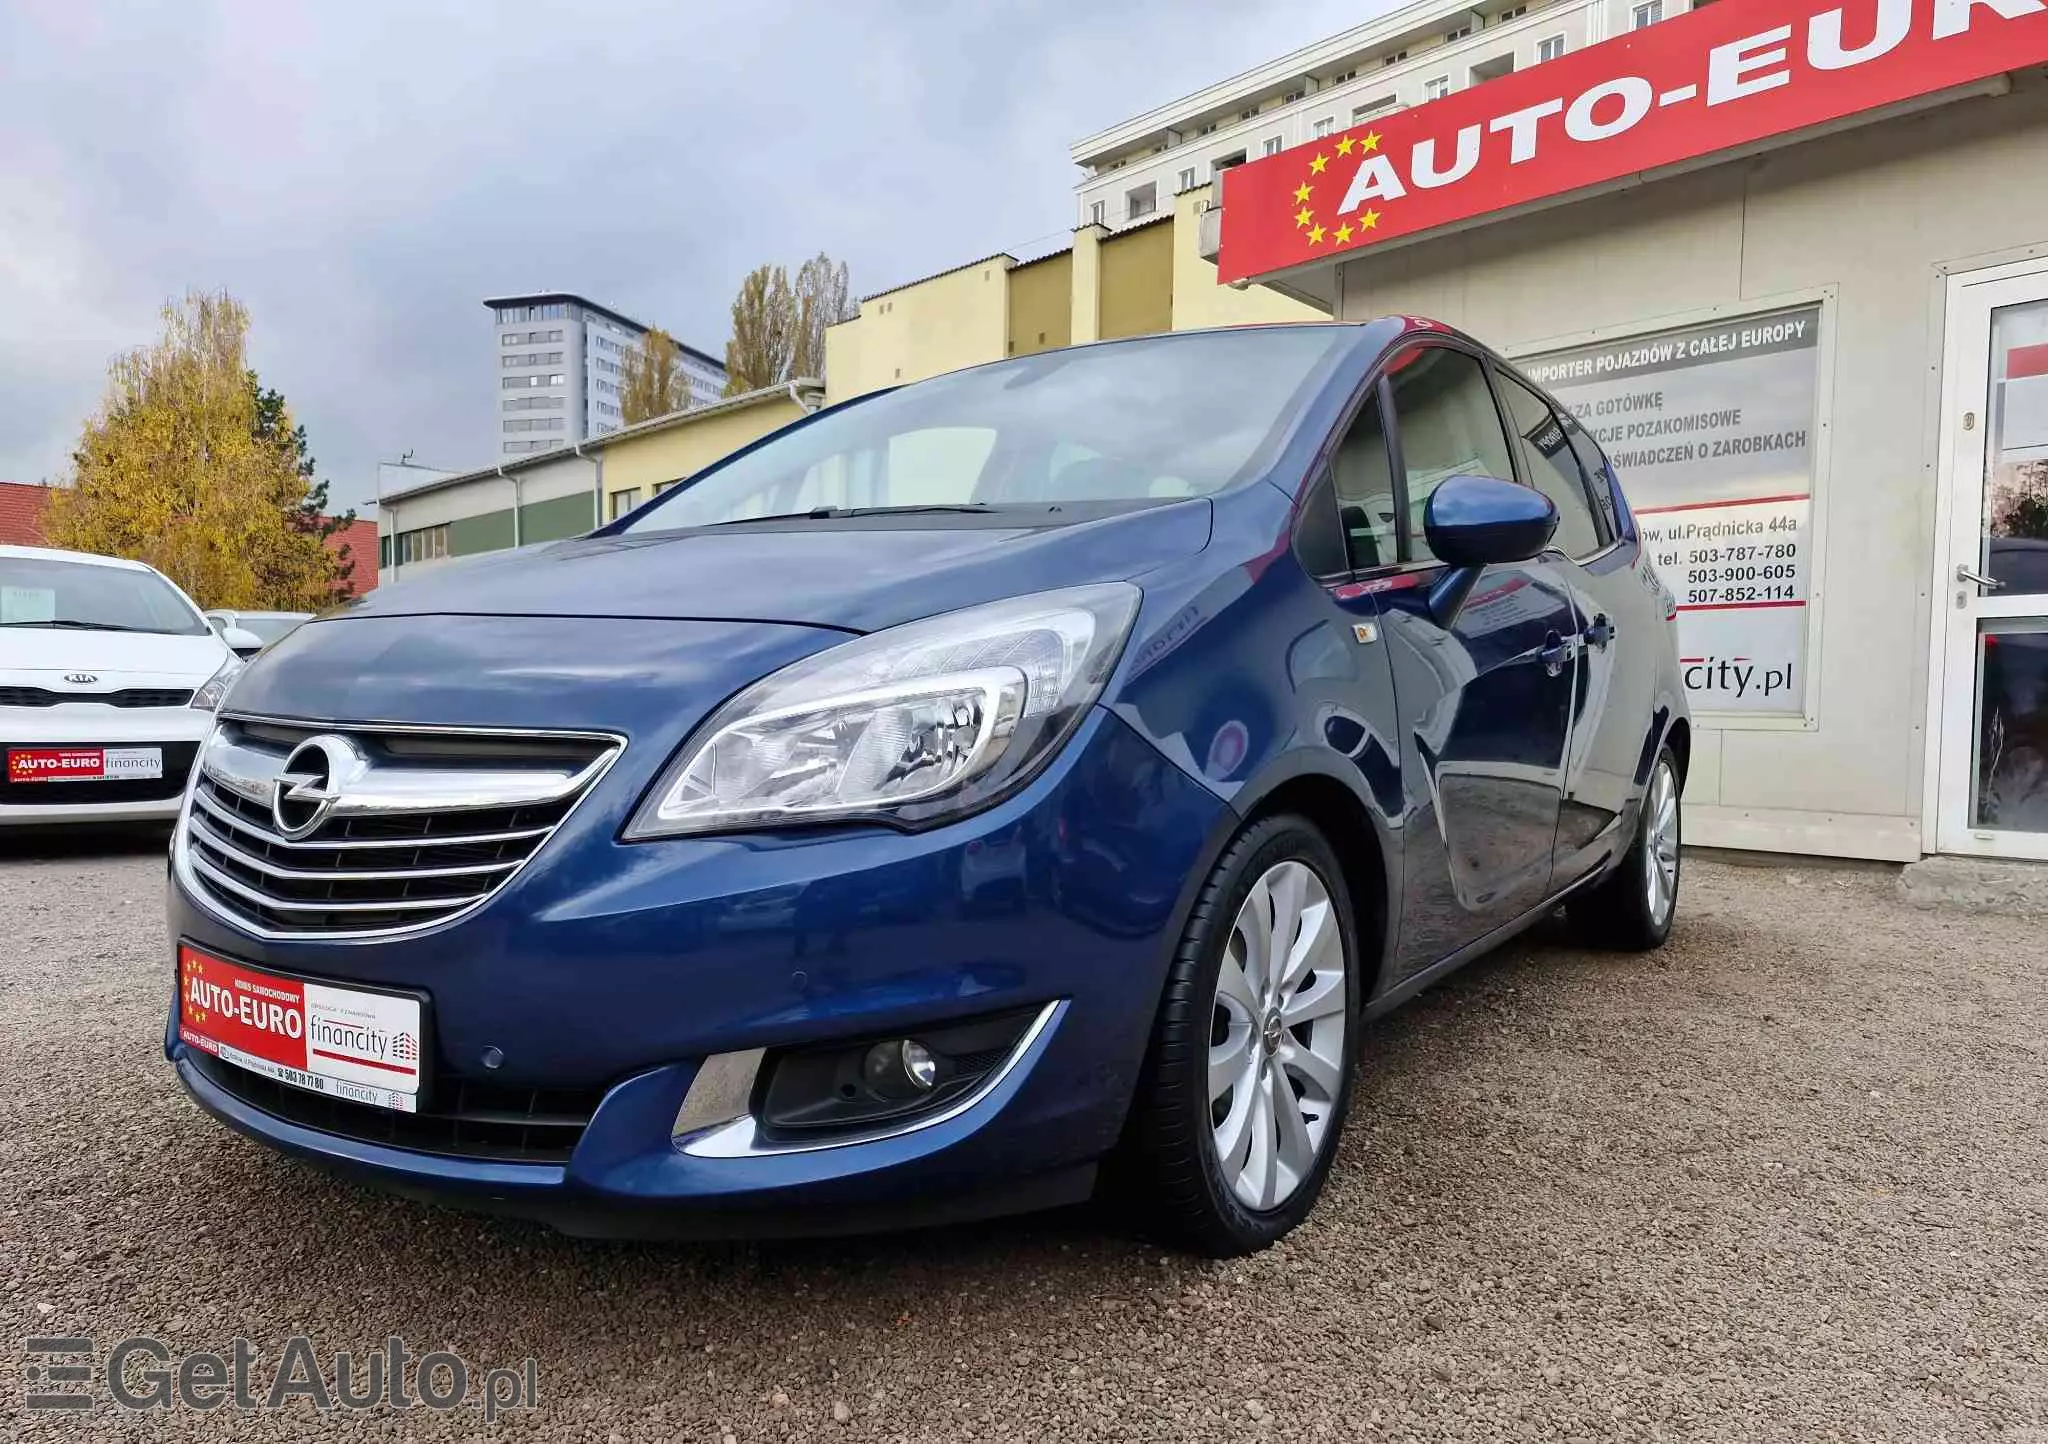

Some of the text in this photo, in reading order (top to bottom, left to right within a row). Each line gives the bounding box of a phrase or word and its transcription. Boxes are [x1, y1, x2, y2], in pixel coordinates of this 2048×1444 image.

[1596, 342, 1672, 373] POJAZDÓW
[1676, 343, 1686, 359] Z
[1690, 334, 1736, 357] CAŁEJ
[1742, 320, 1806, 348] EUROPY
[1596, 392, 1663, 415] GOTÓWKĘ
[1627, 409, 1741, 439] POZAKOMISOWE
[1699, 443, 1708, 458] O
[1712, 430, 1806, 458] ZAROBKACH
[1769, 515, 1797, 532] 44a
[1657, 543, 1796, 566] tel. 503-787-780
[1688, 564, 1796, 584] 503-900-605
[1688, 585, 1794, 603] 507-852-114
[1684, 656, 1792, 698] city.pl
[18, 757, 100, 769] AUTO-EURO
[105, 757, 160, 769] financity
[191, 976, 302, 1039] AUTO-EURO
[311, 1014, 387, 1060] financity
[336, 1080, 378, 1105] financity
